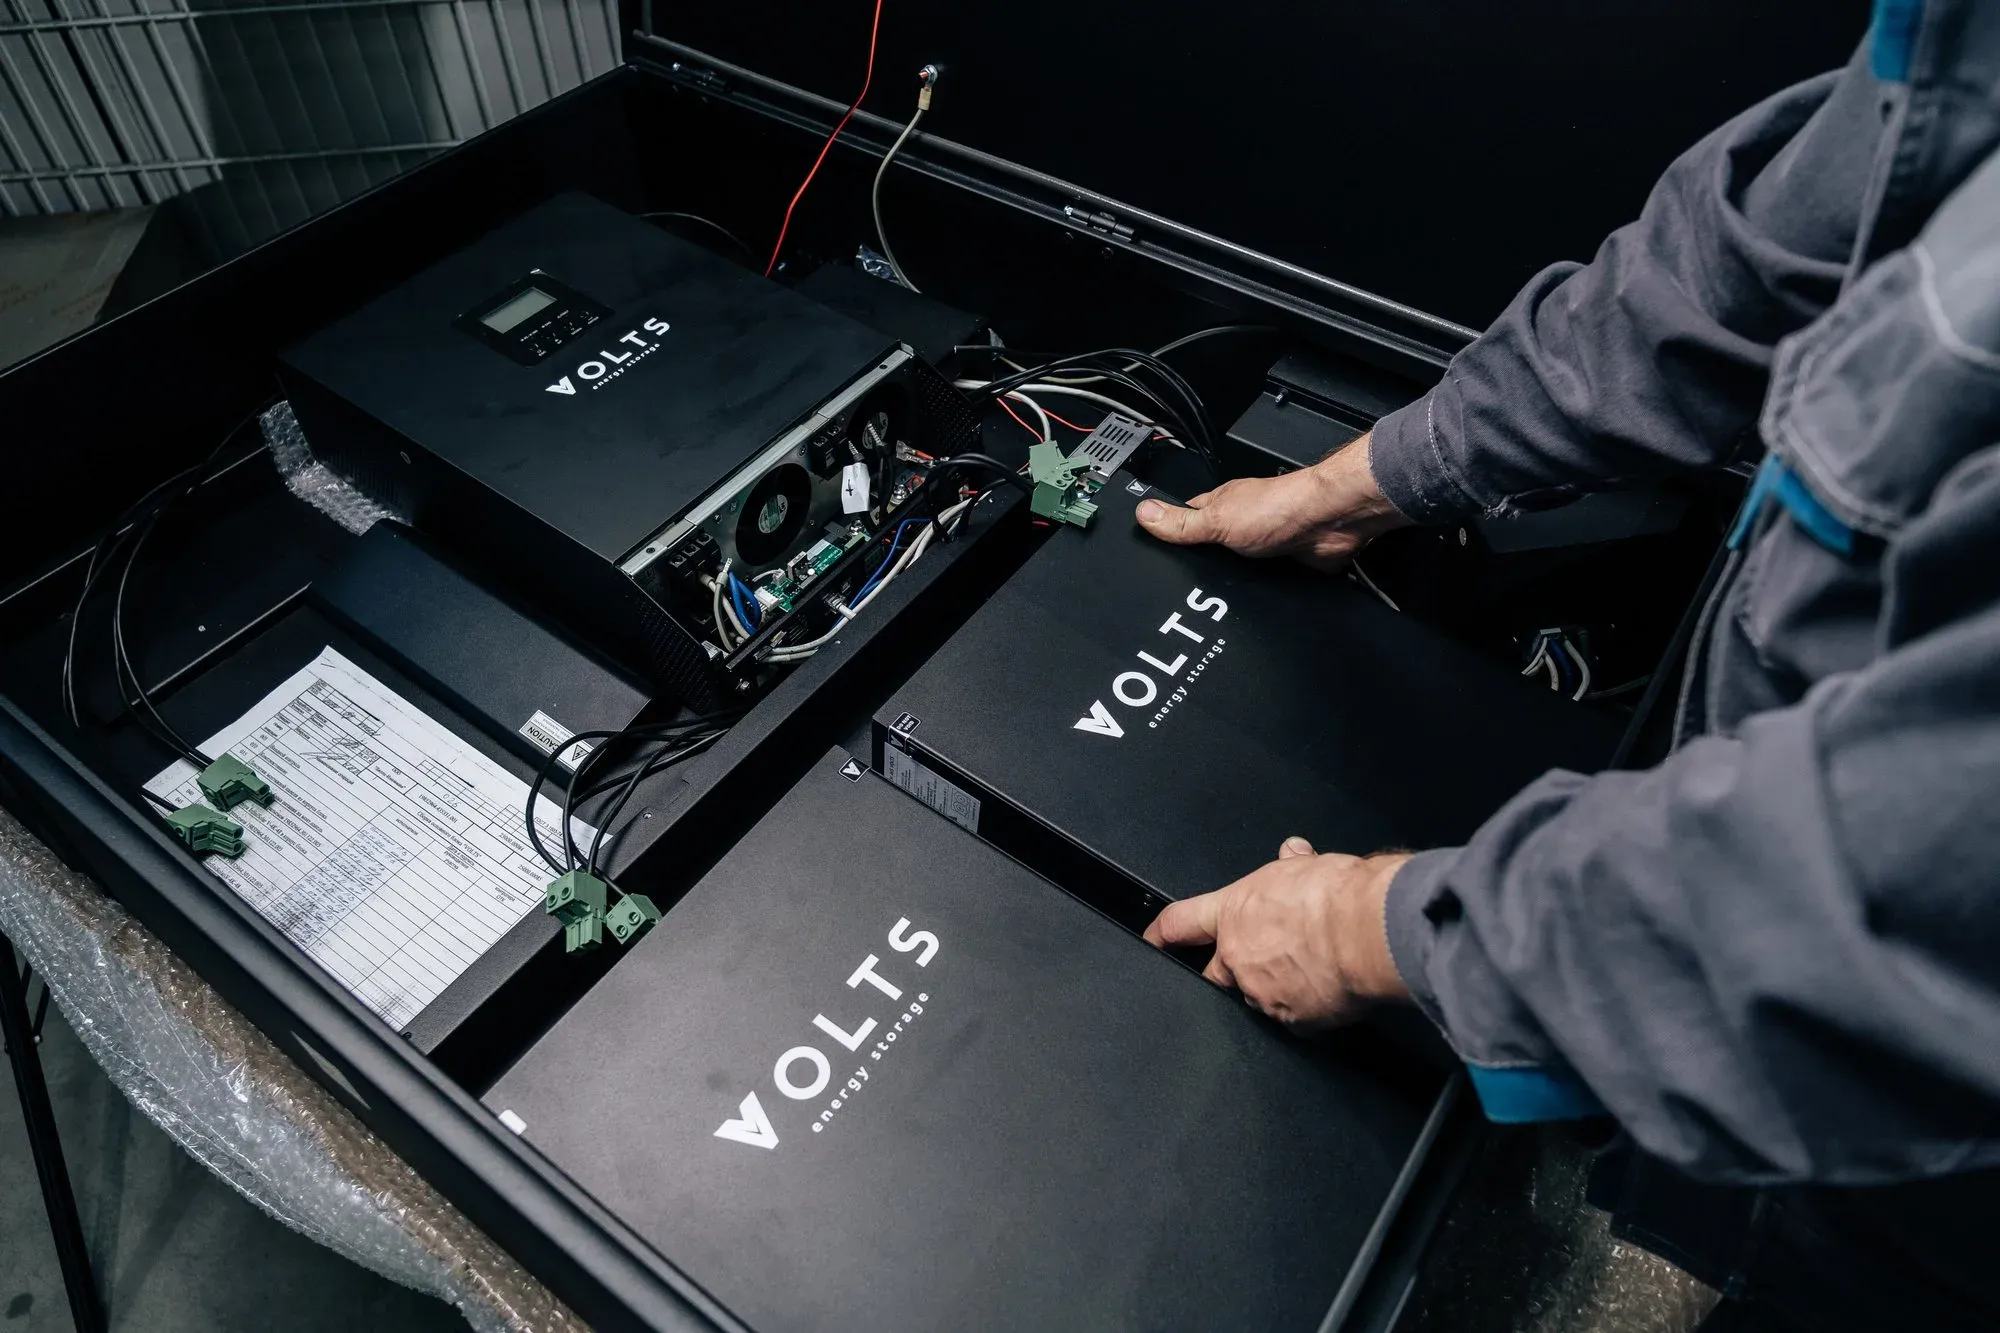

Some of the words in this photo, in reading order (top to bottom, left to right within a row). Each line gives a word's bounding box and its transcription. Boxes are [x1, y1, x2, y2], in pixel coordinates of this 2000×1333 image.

[545, 317, 671, 395] VOLTS
[593, 368, 624, 389] energy
[627, 343, 660, 367] storage
[1072, 587, 1229, 739] VOLTS
[1148, 685, 1188, 729] energy
[1187, 638, 1226, 683] storage
[528, 727, 559, 751] CAUTION
[901, 714, 911, 725] NOT
[904, 720, 914, 731] VOID
[416, 810, 432, 824] Сборка
[430, 820, 451, 838] основного
[449, 834, 463, 846] блока
[712, 916, 940, 1151] VOLTS
[811, 1065, 869, 1133] energy
[870, 992, 929, 1061] storage
